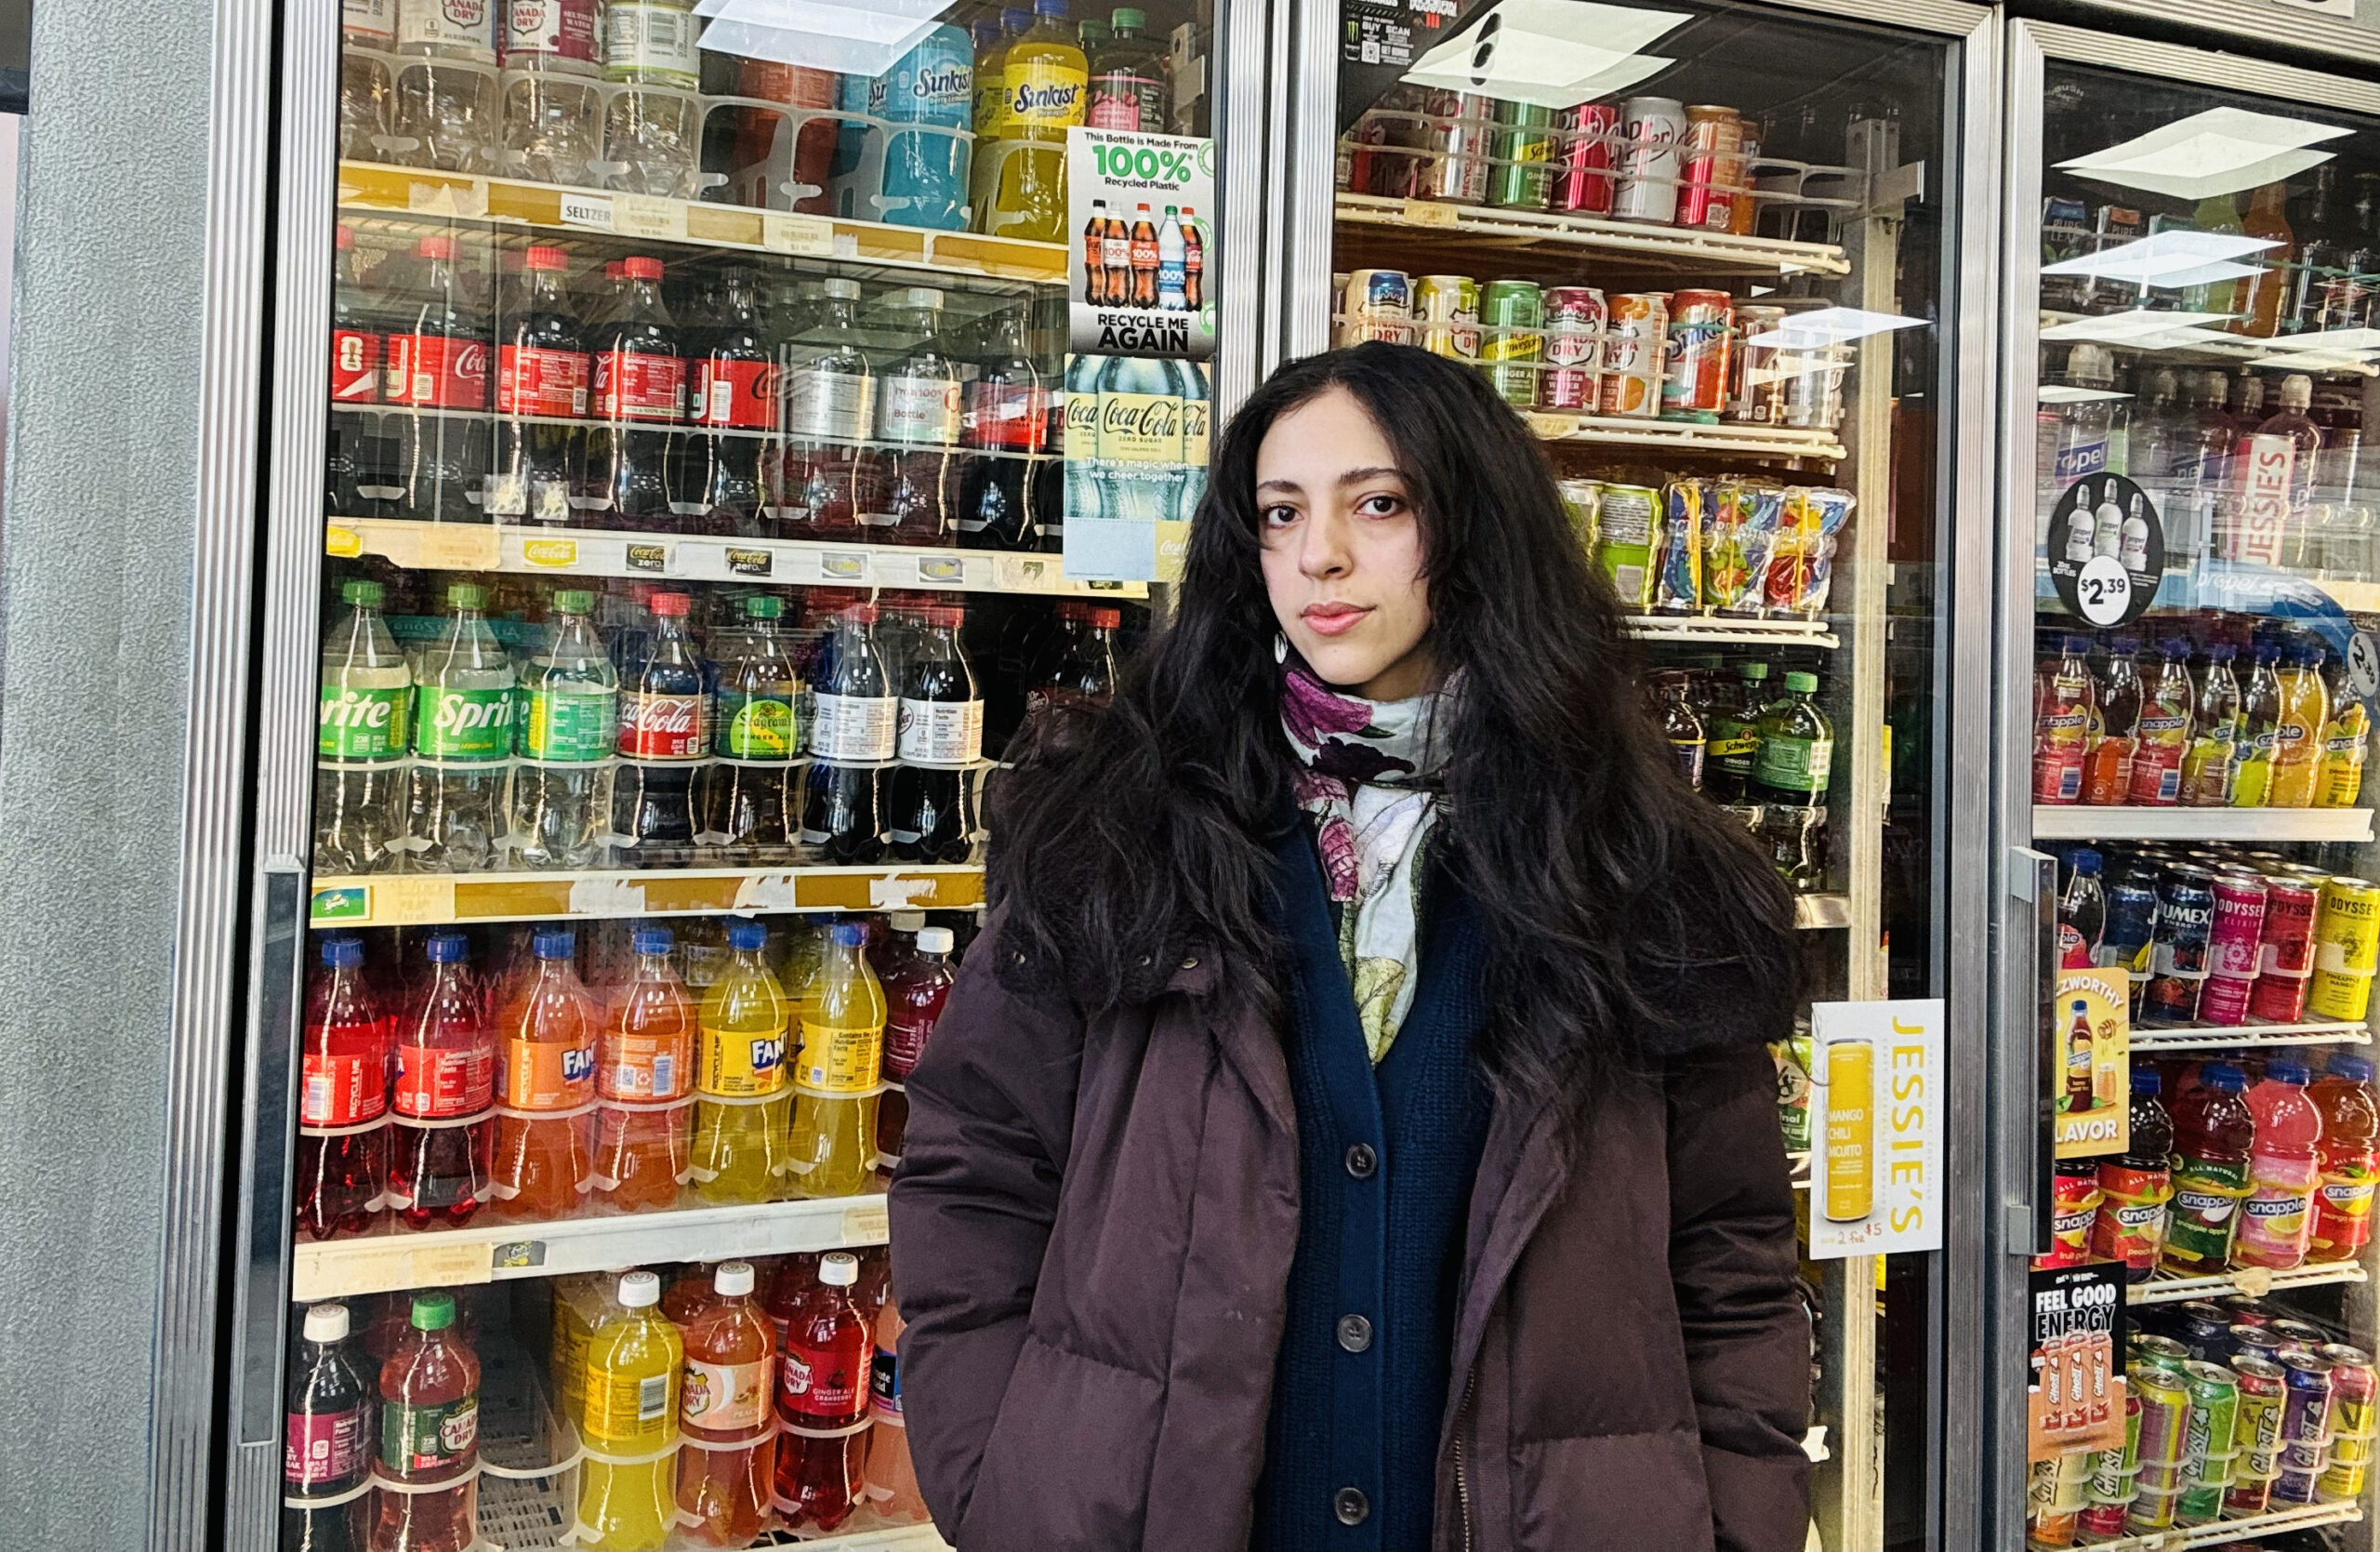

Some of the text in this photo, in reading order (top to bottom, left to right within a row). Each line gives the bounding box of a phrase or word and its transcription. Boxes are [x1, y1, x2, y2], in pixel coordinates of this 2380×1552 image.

[454, 7, 476, 20] DRY
[513, 7, 546, 19] ANADA
[517, 16, 535, 27] DRY
[1361, 20, 1382, 33] BUY
[1385, 25, 1411, 37] SCAN
[913, 66, 973, 100] Sunkist
[1013, 83, 1080, 113] Sunkist
[1085, 132, 1198, 151] This Bottle is Made From
[1091, 144, 1192, 183] 100%
[1104, 176, 1181, 192] Recycled Plastic
[565, 205, 612, 223] SELTZER
[1132, 248, 1157, 259] 100%
[1158, 269, 1185, 284] 100%
[1098, 313, 1189, 330] RECYCLE ME
[1098, 327, 1189, 352] AGAIN
[1552, 344, 1583, 355] DRY
[893, 409, 927, 420] Bottle
[1103, 397, 1178, 437] Coca-Cola
[1086, 457, 1189, 471] There's magic when
[1090, 470, 1186, 484] we cheer together
[2081, 578, 2126, 605] $2.39
[320, 691, 390, 727] rite
[2141, 718, 2185, 729] snapple
[2218, 897, 2264, 918] ODYSSE
[350, 1058, 362, 1119] RECYCLE ME
[1828, 1108, 1864, 1121] MANGO
[1890, 1015, 1925, 1234] JESSIE'S
[1828, 1127, 1851, 1140] CHILI
[1828, 1144, 1863, 1158] MOJITO
[2058, 1182, 2074, 1193] ALL
[2128, 1176, 2145, 1186] ALL
[2181, 1193, 2235, 1208] snapple
[2248, 1198, 2307, 1214] snapple
[1837, 1231, 1846, 1245] 2
[1865, 1223, 1883, 1237] $5
[2036, 1283, 2117, 1313] FEEL GOOD
[2035, 1303, 2117, 1342] ENERGY
[786, 1362, 813, 1386] ANADA
[684, 1383, 711, 1396] NADA
[787, 1376, 802, 1389] DRY
[813, 1387, 841, 1396] GINGER
[813, 1394, 853, 1402] CRANBERRY
[454, 1428, 475, 1445] DRY
[2294, 1411, 2321, 1468] GHOST
[2250, 1415, 2277, 1475] GHOST
